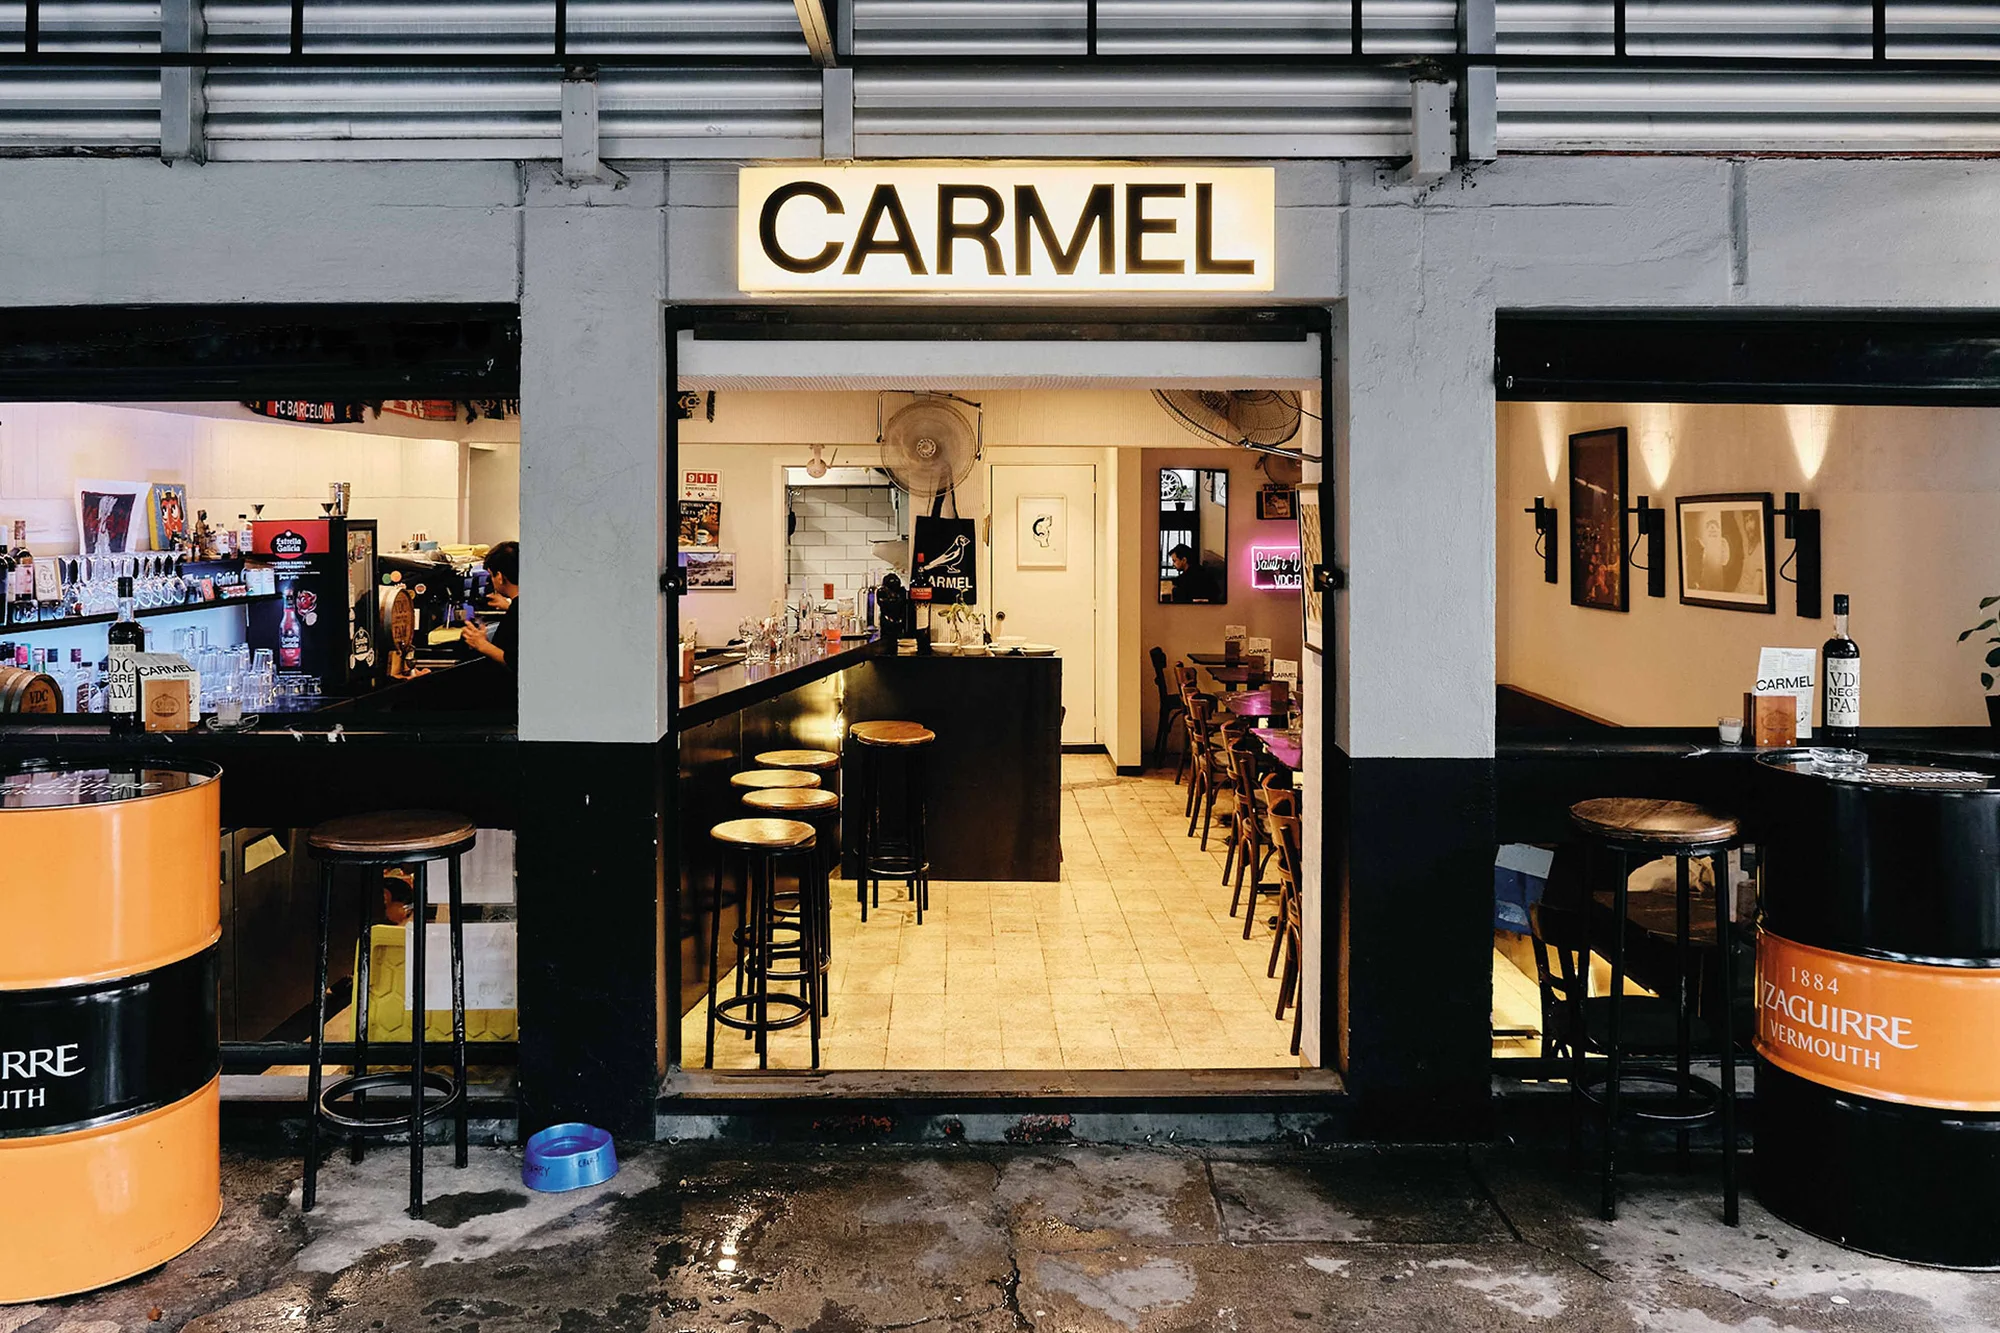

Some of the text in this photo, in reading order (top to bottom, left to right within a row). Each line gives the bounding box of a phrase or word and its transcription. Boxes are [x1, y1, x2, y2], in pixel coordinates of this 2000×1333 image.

[759, 181, 1255, 275] CARMEL
[287, 400, 335, 419] BARCELONA
[687, 474, 716, 483] 911
[276, 537, 302, 545] Estrella
[277, 544, 301, 552] Galicia
[216, 571, 239, 586] Galicia
[928, 575, 973, 589] ARMEL
[110, 658, 134, 673] DC
[137, 664, 196, 677] CARMEL
[1756, 675, 1814, 691] CARMEL
[29, 689, 48, 704] VDC
[109, 684, 135, 699] AM
[1791, 966, 1839, 995] 1884
[1770, 1019, 1881, 1070] VERMOUTH
